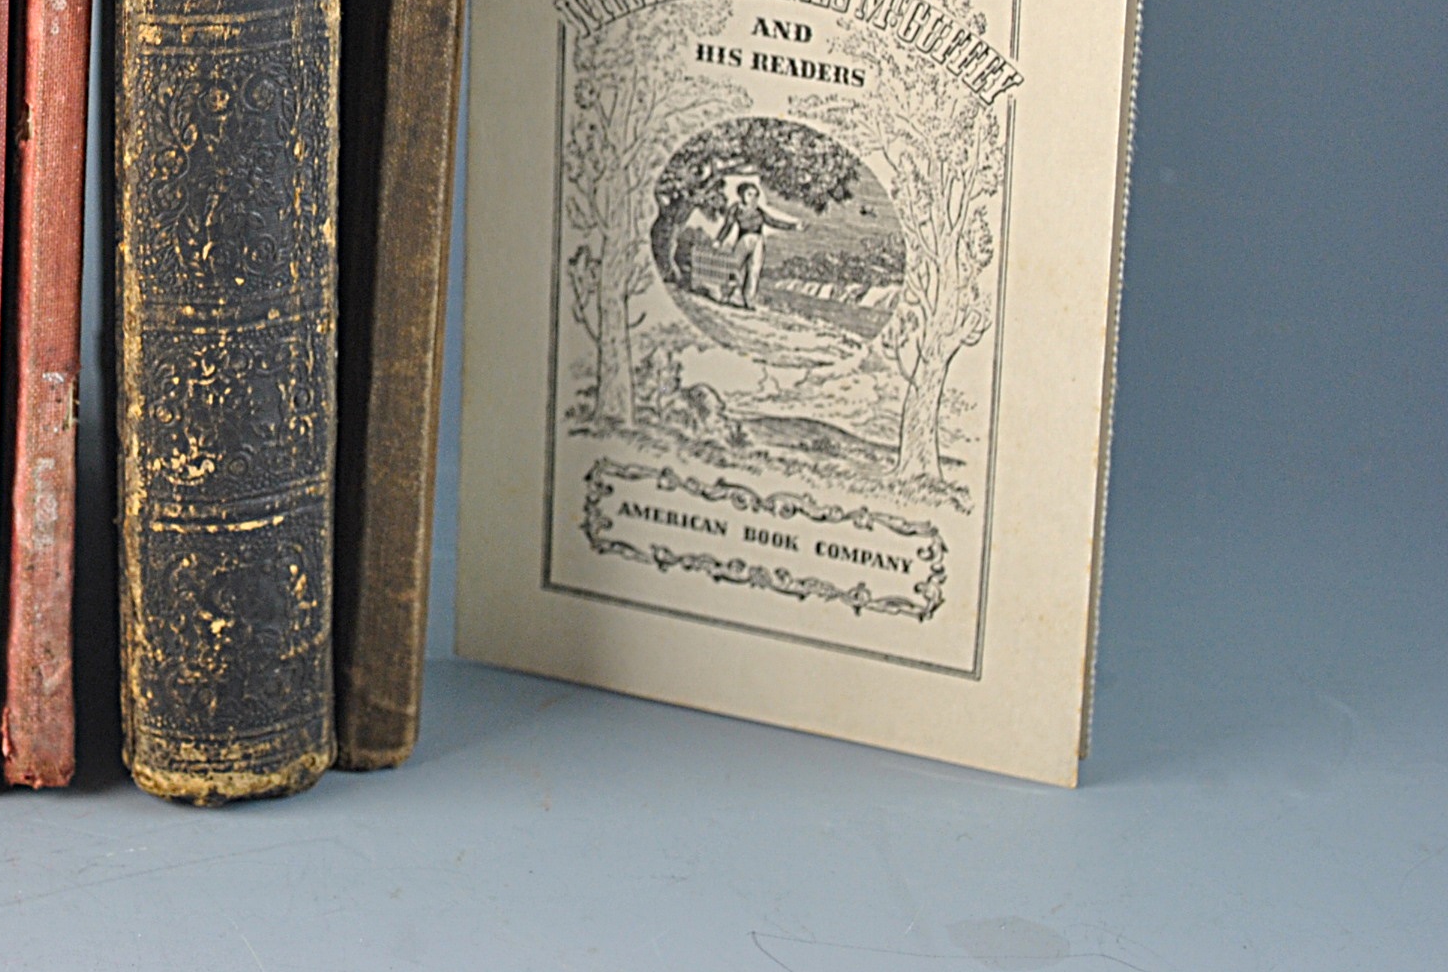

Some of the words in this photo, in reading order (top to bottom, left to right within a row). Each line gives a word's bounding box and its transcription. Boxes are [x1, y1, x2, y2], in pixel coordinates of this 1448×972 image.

[752, 17, 812, 42] AND
[696, 44, 742, 66] HIS
[751, 52, 865, 87] READERS
[618, 501, 727, 535] AMERICAN
[744, 527, 798, 551] BOOK
[815, 541, 912, 573] COMPANY
